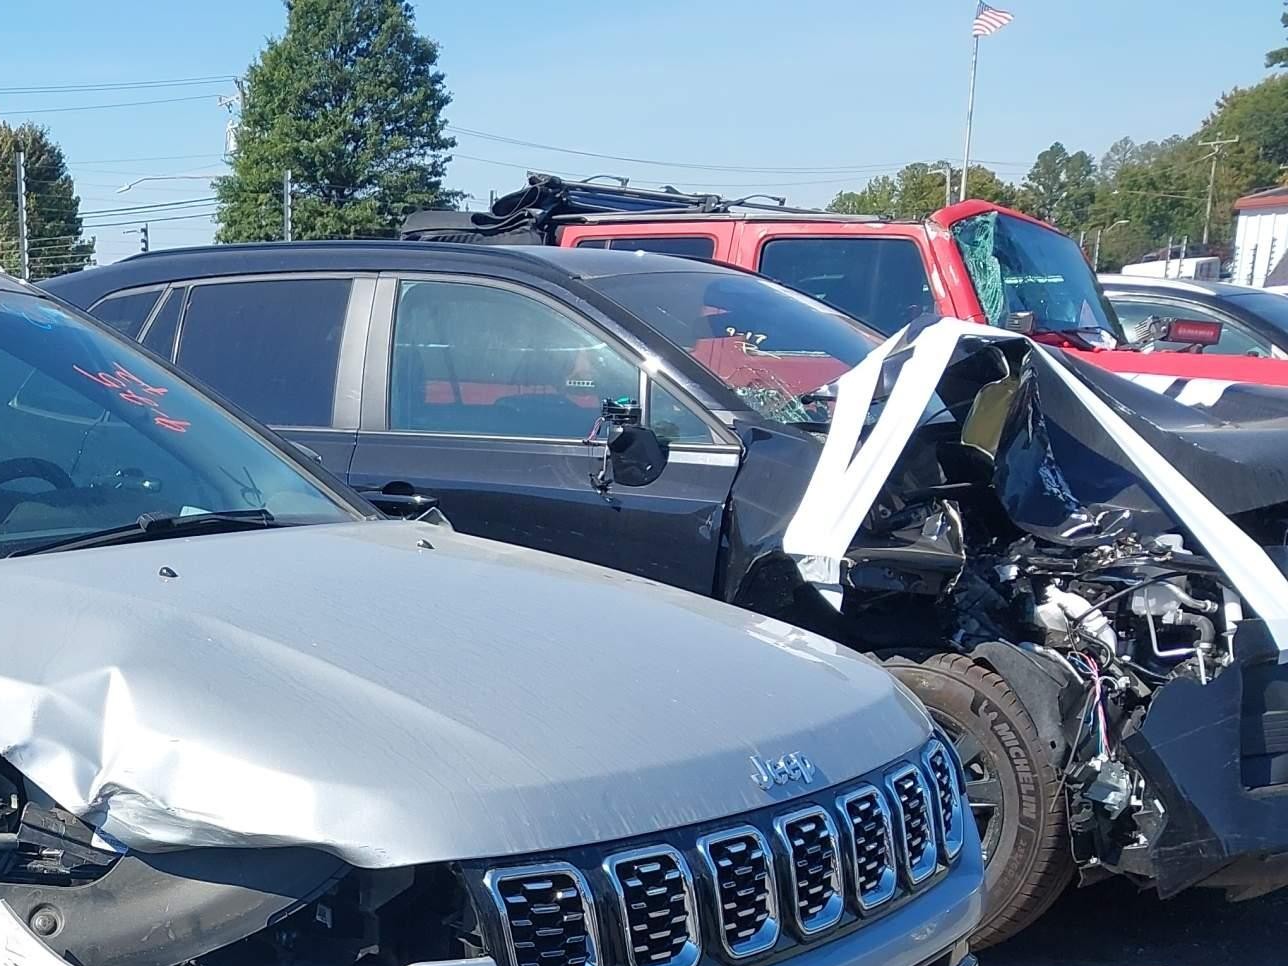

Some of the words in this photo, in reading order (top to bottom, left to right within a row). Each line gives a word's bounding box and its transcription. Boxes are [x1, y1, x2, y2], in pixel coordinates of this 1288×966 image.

[726, 327, 768, 345] 9-17
[749, 751, 816, 790] Jeep
[993, 721, 1036, 820] MICHELIN
